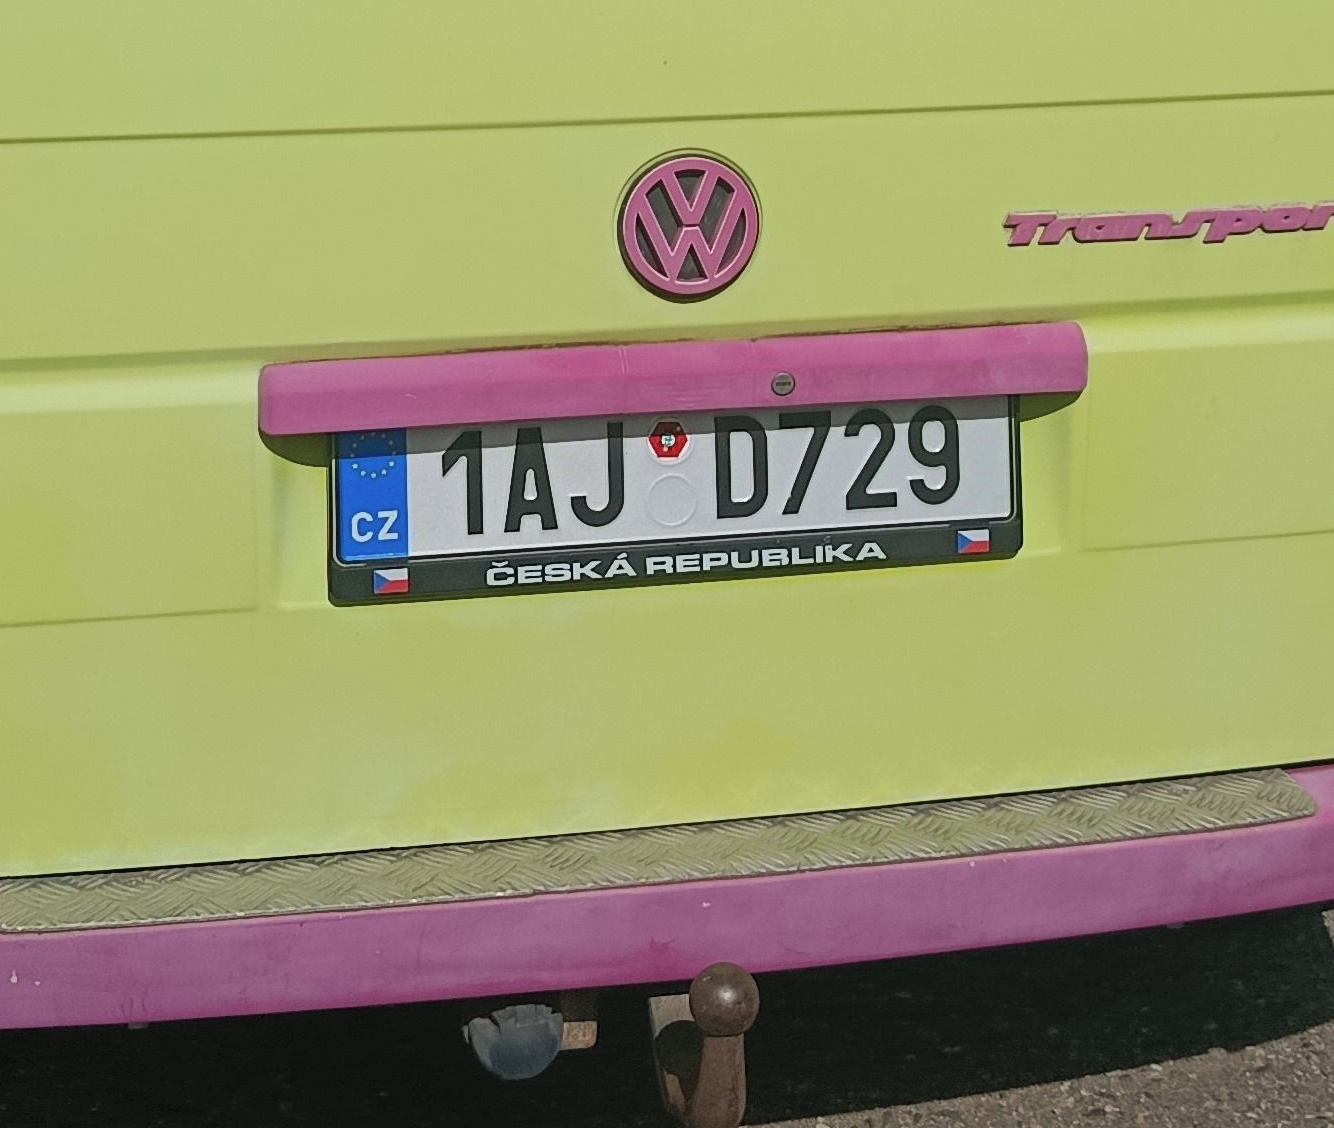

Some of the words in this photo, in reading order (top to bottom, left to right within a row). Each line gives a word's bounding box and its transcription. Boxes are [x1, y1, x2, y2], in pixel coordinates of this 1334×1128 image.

[441, 421, 625, 536] 1AJ
[714, 405, 960, 519] D729
[350, 509, 399, 543] CZ
[486, 552, 637, 586] ČESKÁ
[645, 542, 887, 575] REPUBLIKA
